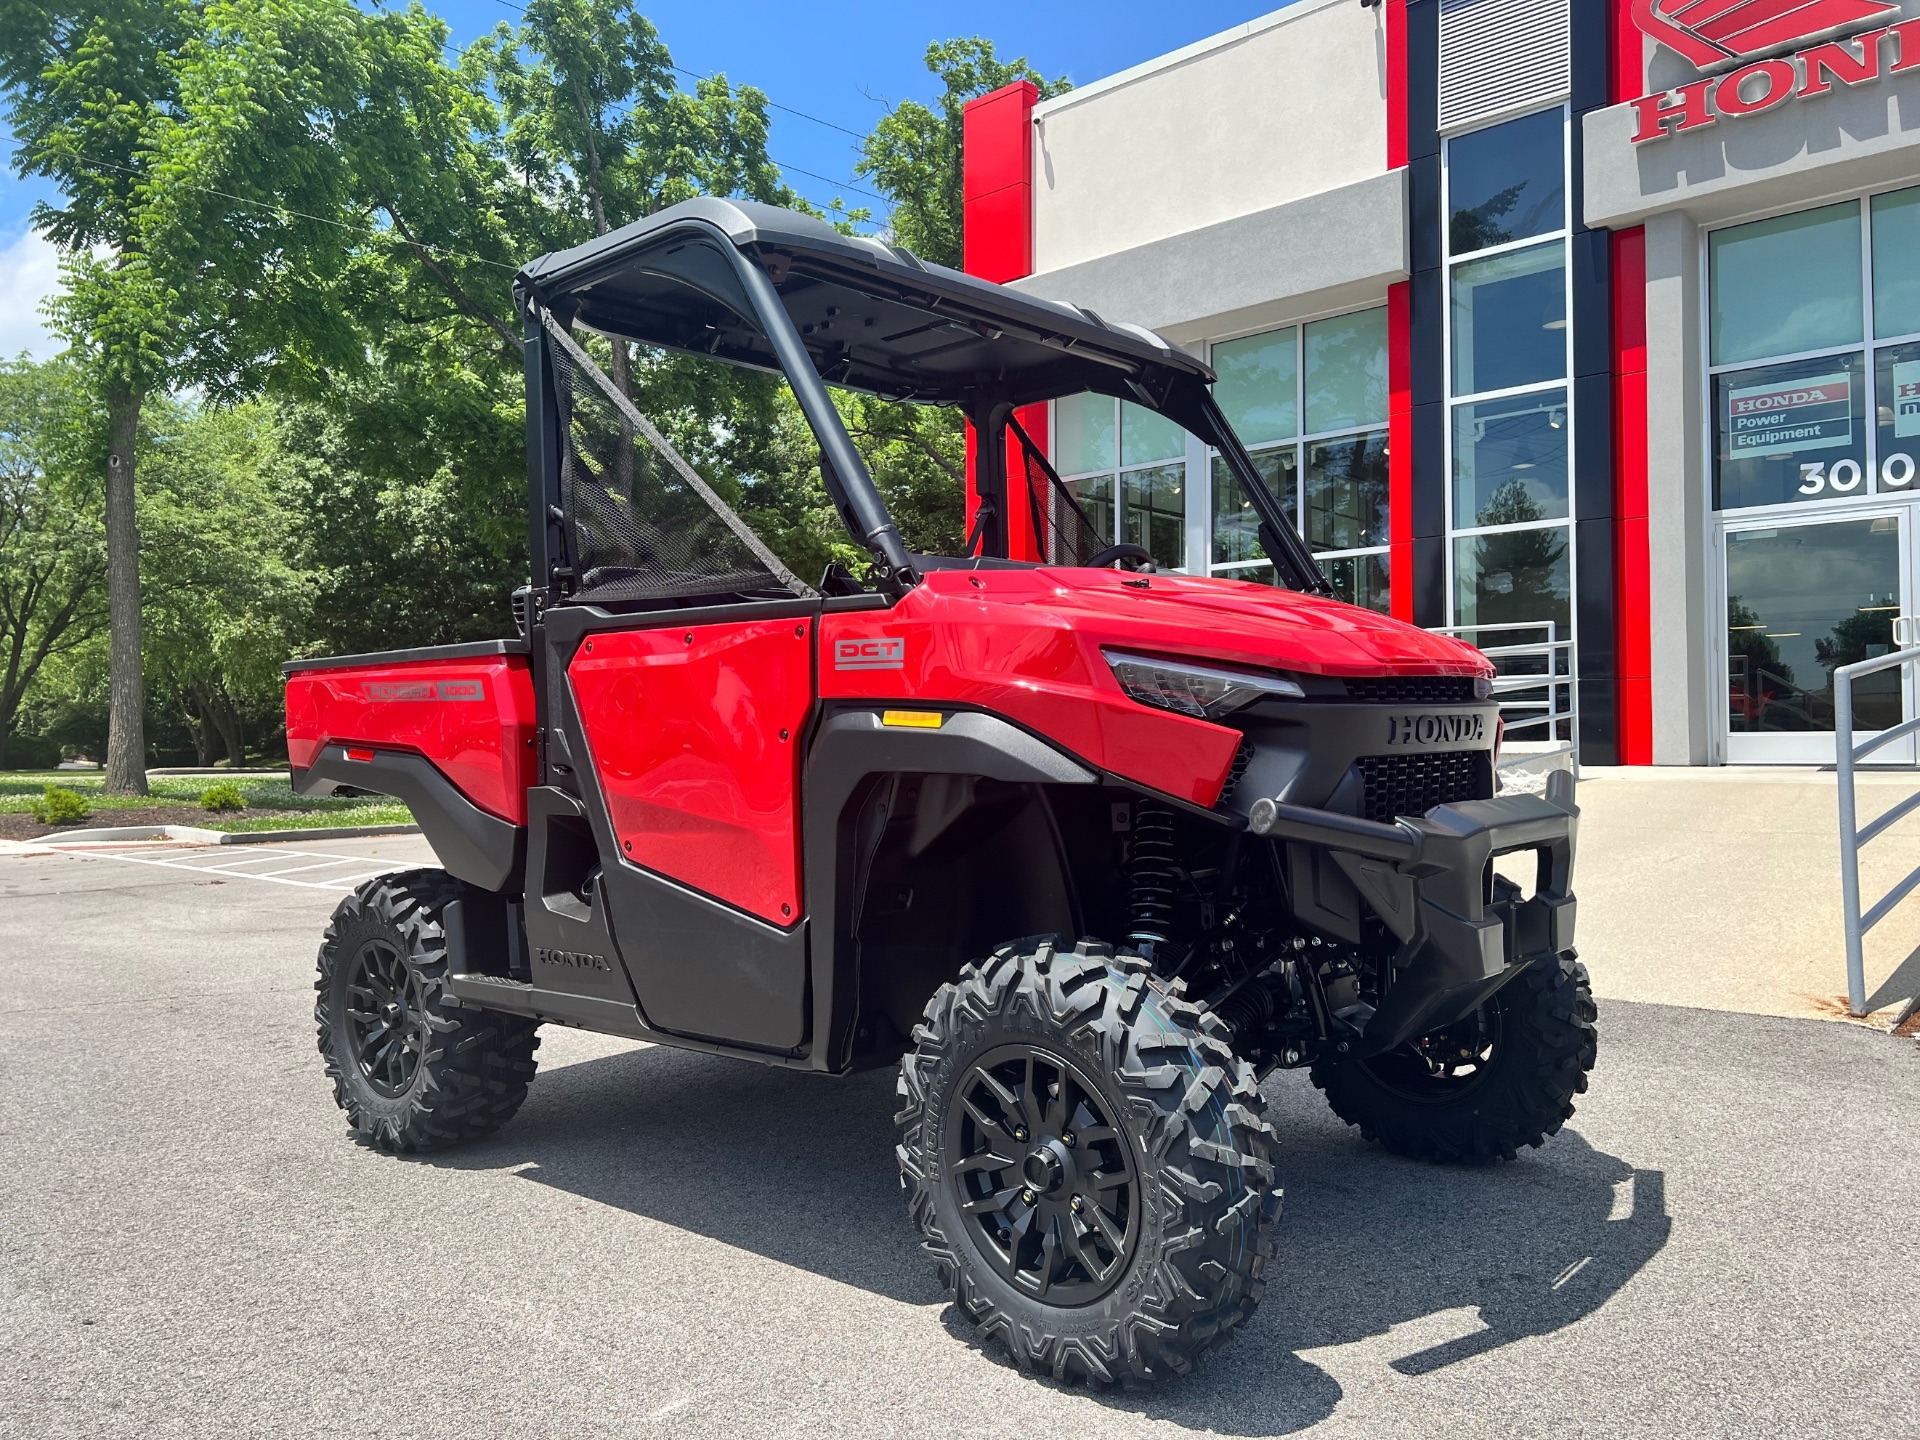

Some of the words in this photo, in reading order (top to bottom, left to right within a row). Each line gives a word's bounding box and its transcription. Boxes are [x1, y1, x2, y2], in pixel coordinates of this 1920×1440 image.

[1736, 389, 1828, 413] HONDA
[1737, 412, 1787, 429] Power
[1737, 424, 1821, 446] Equipment
[839, 642, 900, 658] DCT
[1387, 713, 1486, 745] HONDA
[535, 947, 612, 972] HONDA
